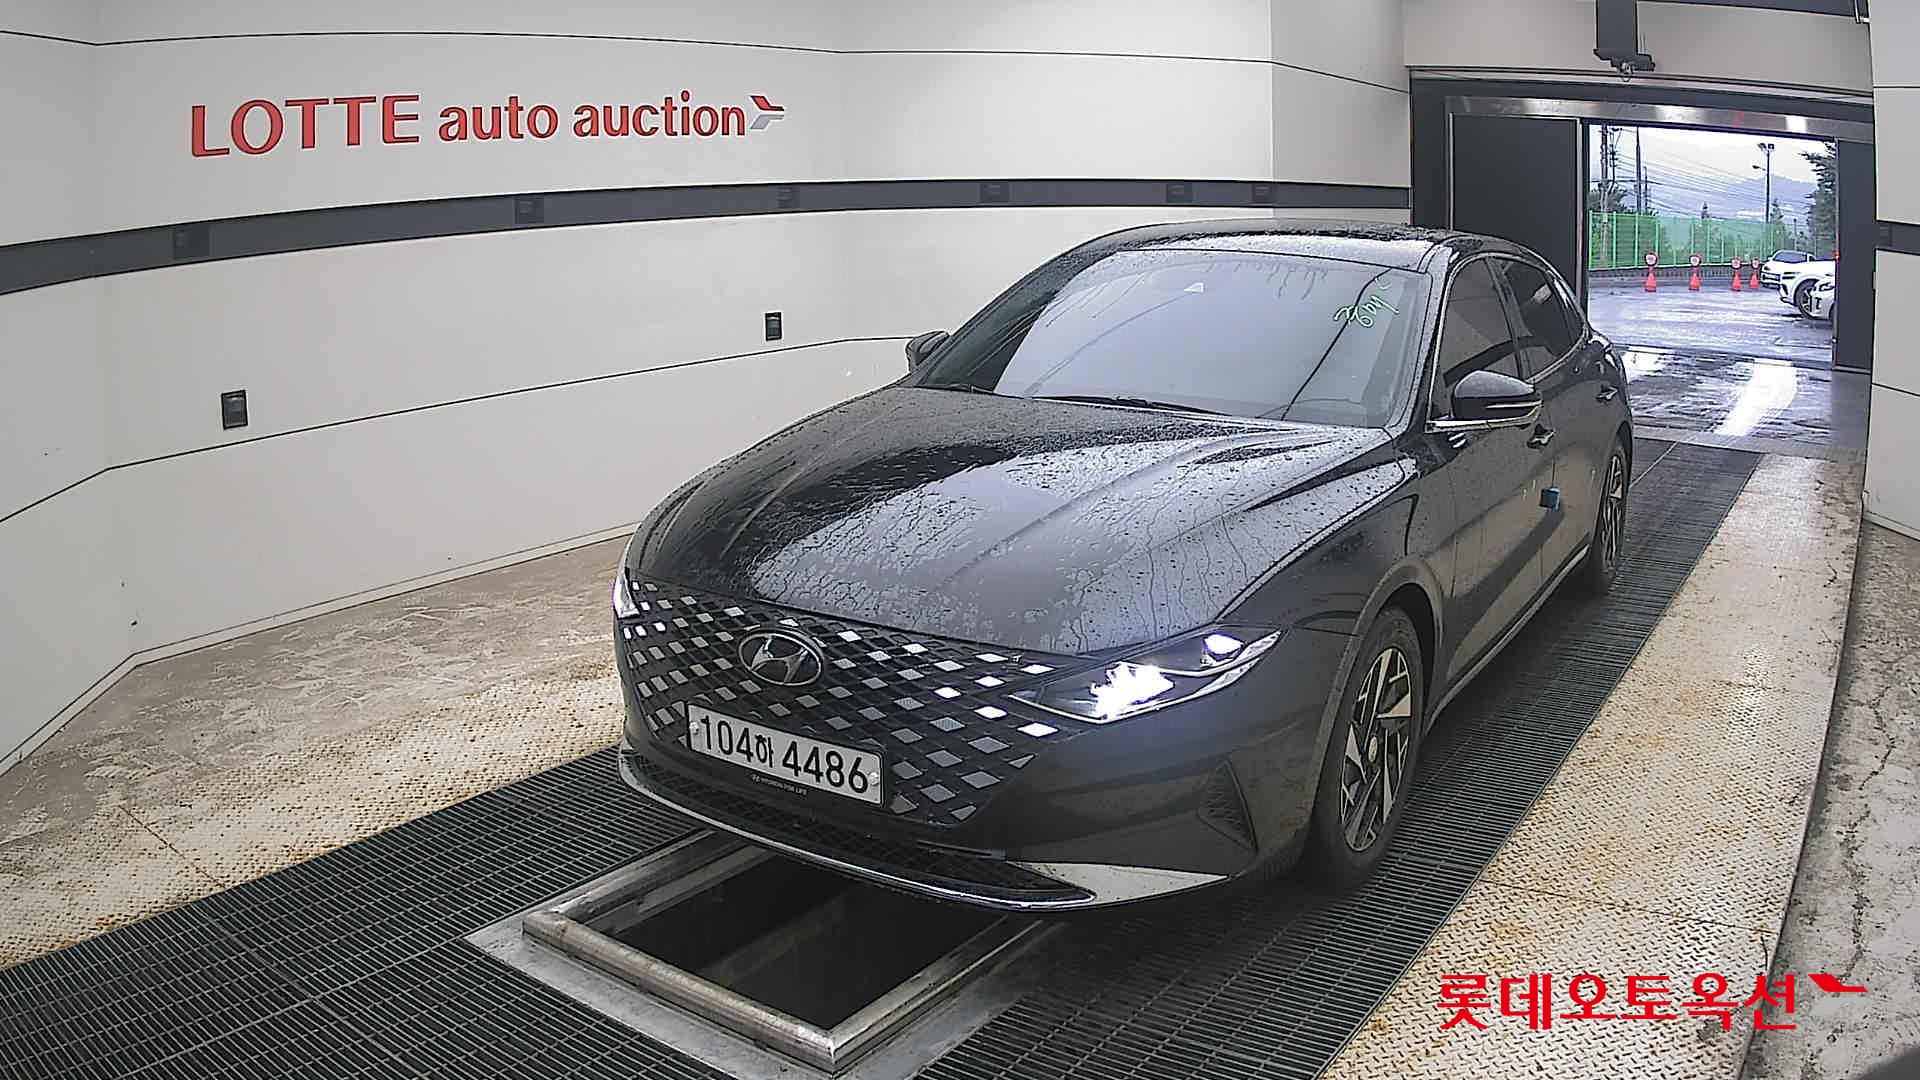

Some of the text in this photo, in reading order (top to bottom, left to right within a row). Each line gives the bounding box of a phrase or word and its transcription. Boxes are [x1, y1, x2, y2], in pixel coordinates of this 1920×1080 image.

[191, 91, 746, 158] LOTTE auto auction
[701, 715, 868, 794] 104하 4486
